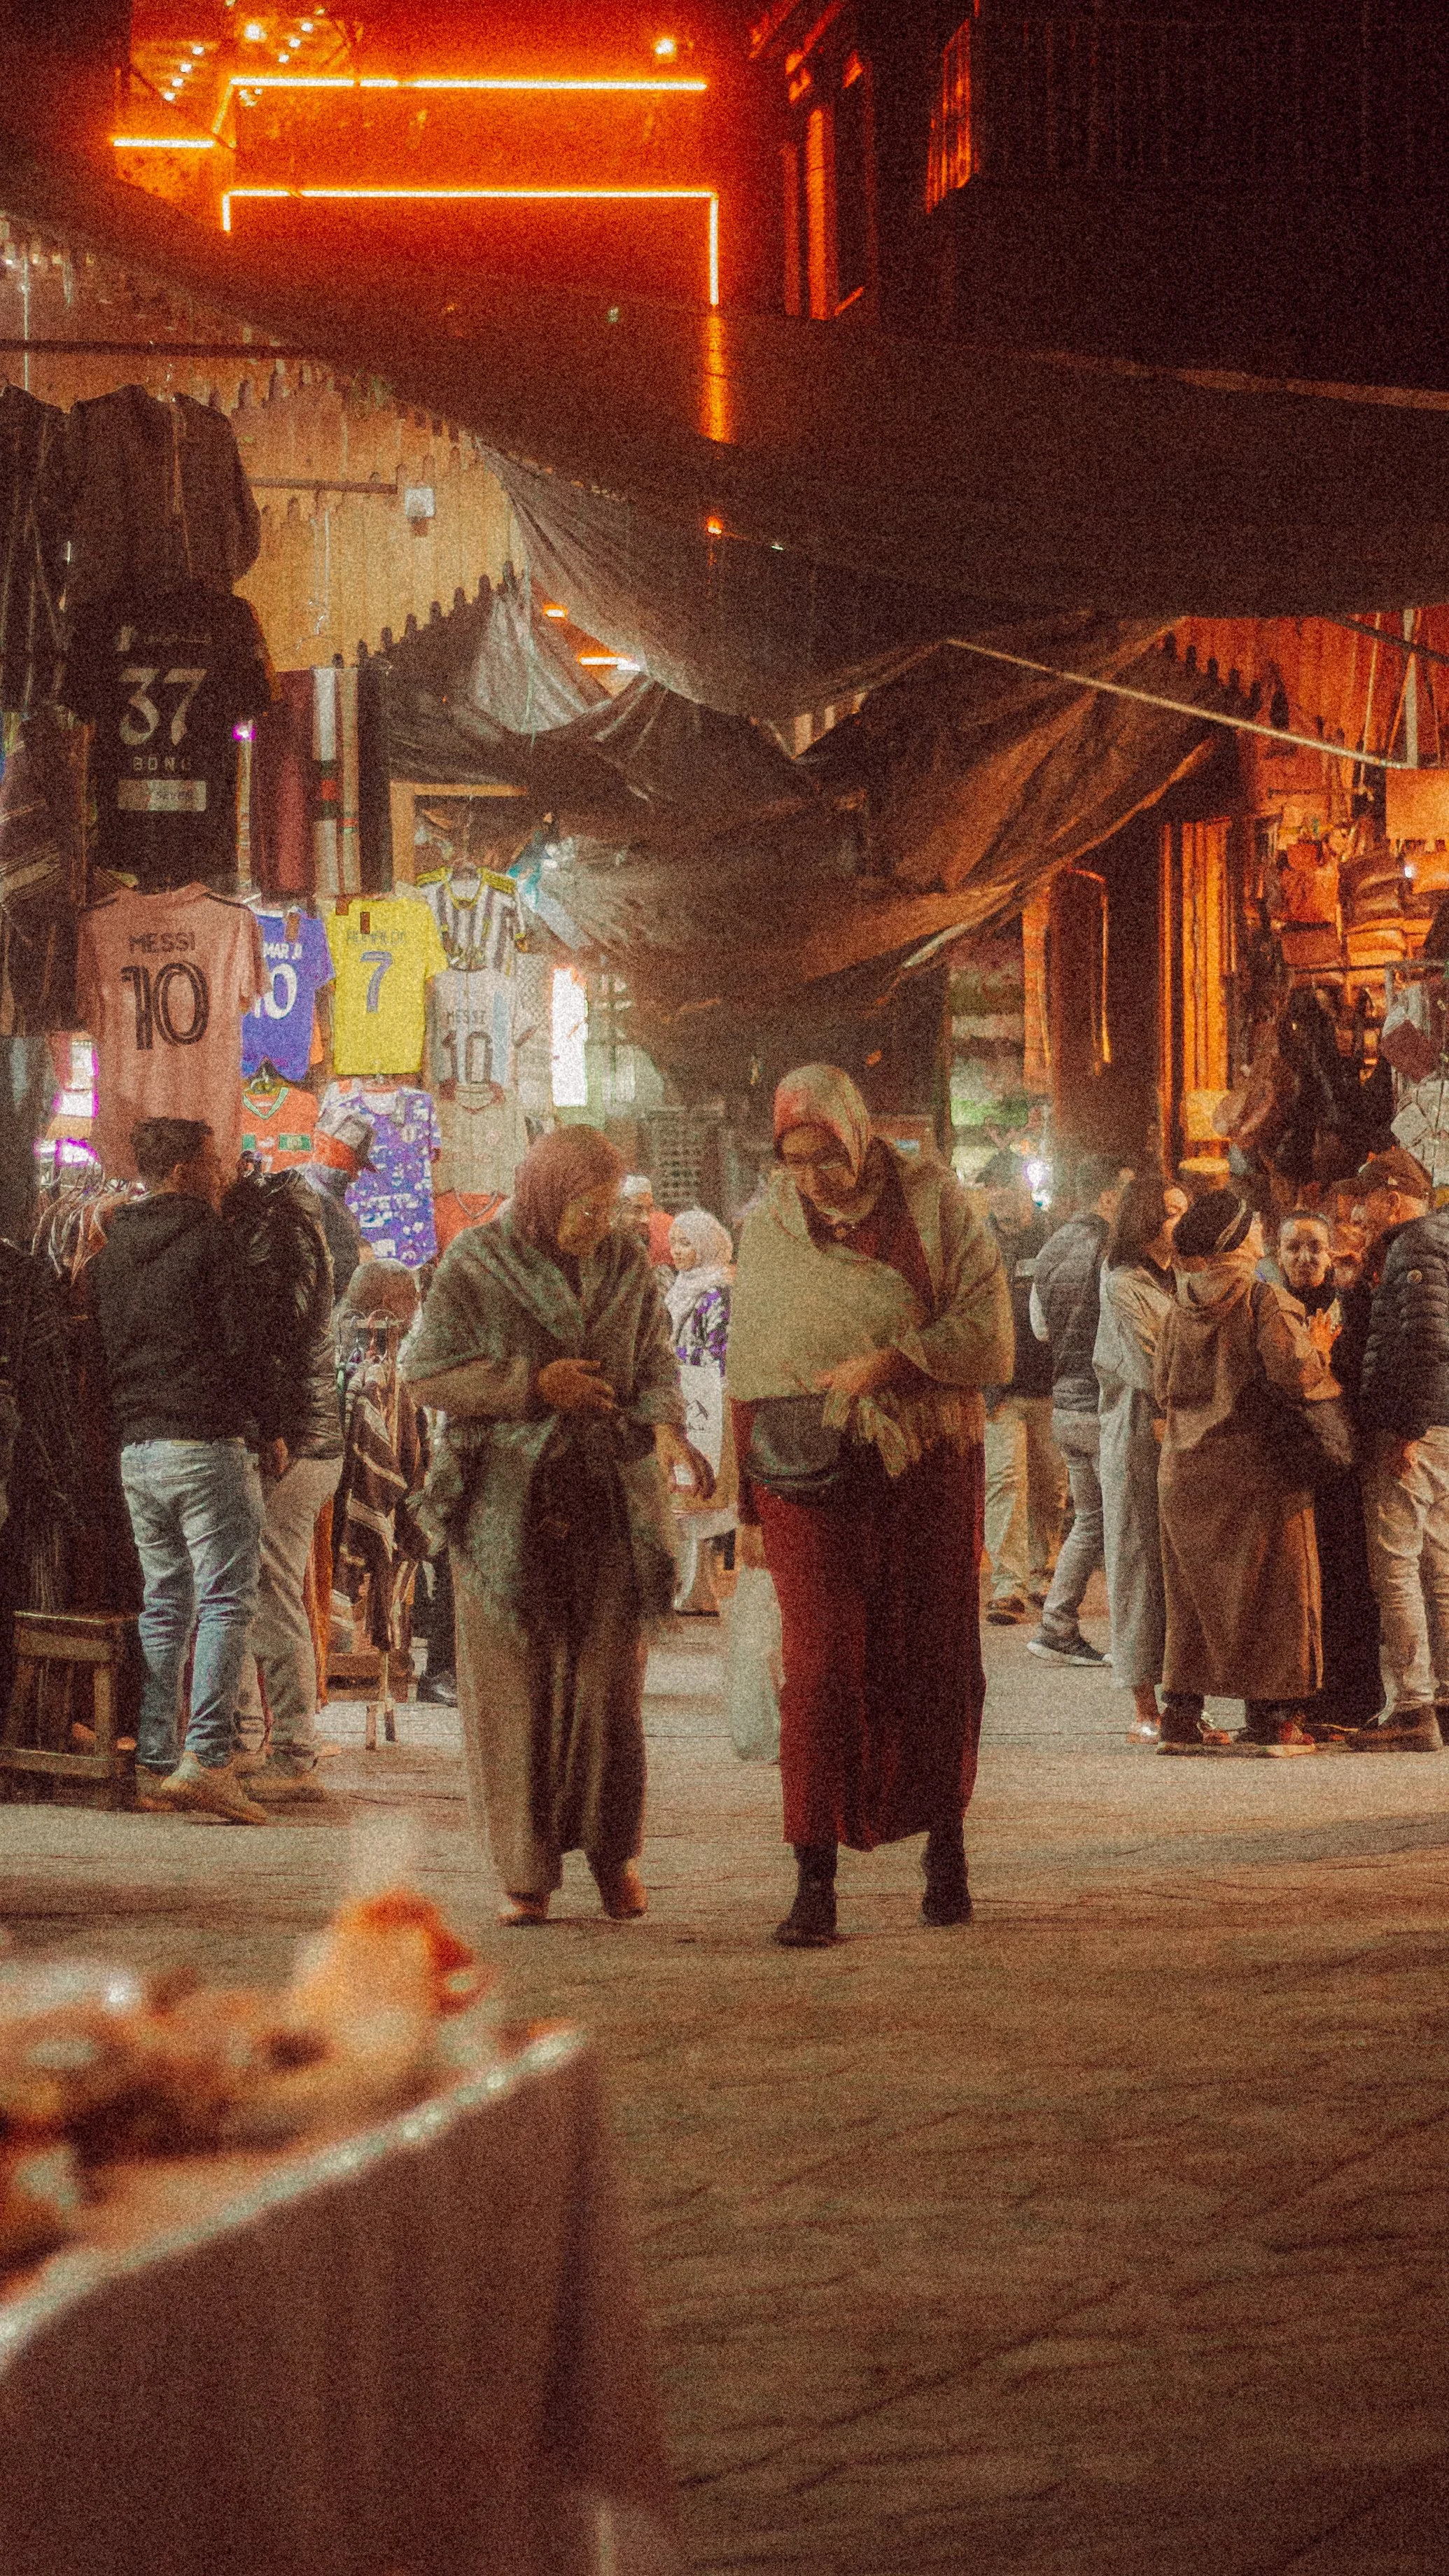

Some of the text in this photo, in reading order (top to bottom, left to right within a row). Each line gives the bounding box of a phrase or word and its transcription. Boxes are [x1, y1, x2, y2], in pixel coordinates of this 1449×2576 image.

[118, 668, 207, 746] 37
[129, 932, 195, 953] MESSI
[262, 942, 288, 960] MAR
[120, 960, 210, 1051] 10
[360, 951, 393, 1013] 7
[442, 1009, 486, 1027] MESSI
[442, 1030, 493, 1084] 10
